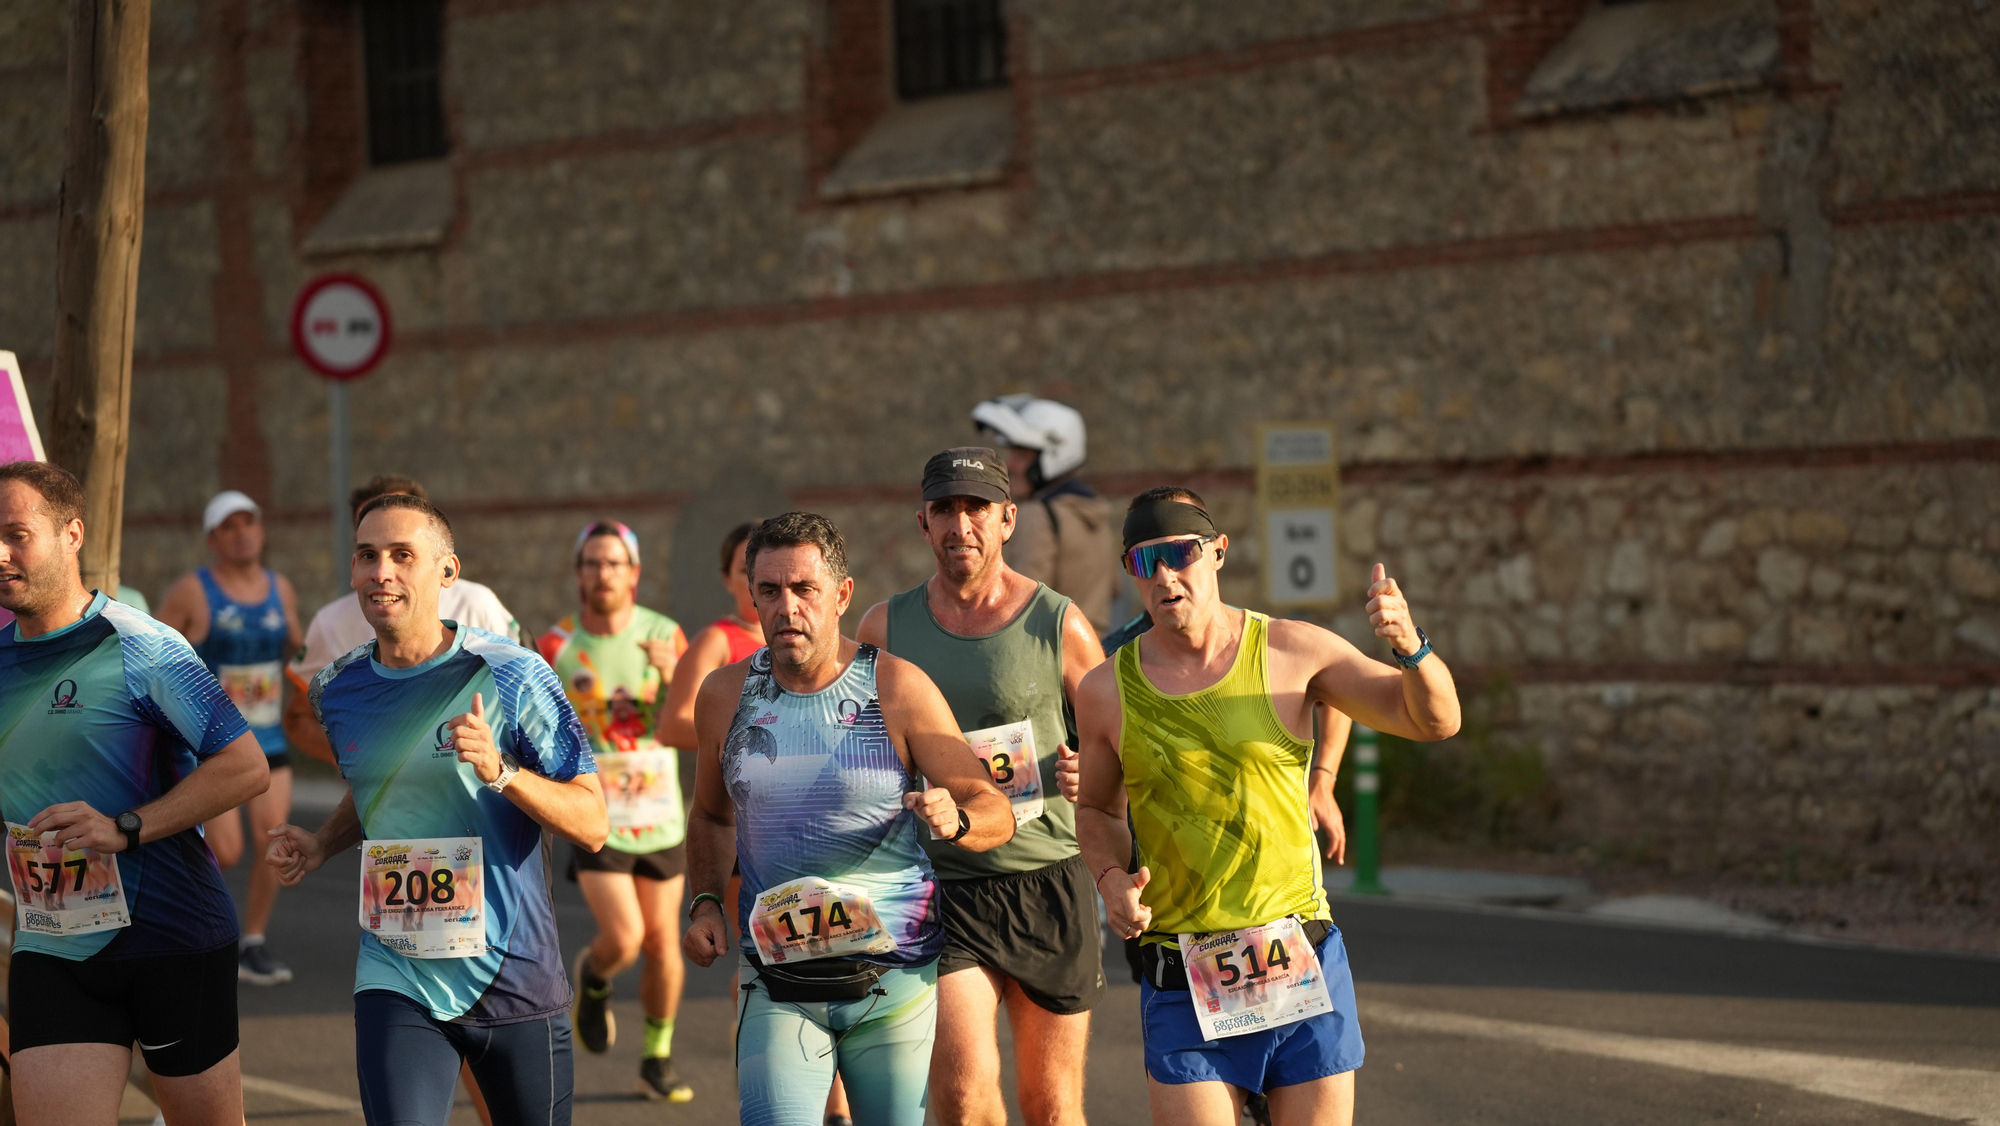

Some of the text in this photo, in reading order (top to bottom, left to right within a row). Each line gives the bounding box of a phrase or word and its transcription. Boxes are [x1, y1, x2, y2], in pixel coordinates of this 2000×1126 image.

[952, 458, 984, 470] FILA
[1288, 554, 1316, 591] 0
[27, 858, 88, 894] 577
[385, 868, 455, 906] 208
[778, 901, 852, 942] 174
[1199, 932, 1236, 952] CORDOBA
[1215, 938, 1290, 987] 514
[1286, 978, 1316, 990] serizona
[1213, 1012, 1256, 1026] carreras
[1214, 1016, 1266, 1034] populares
